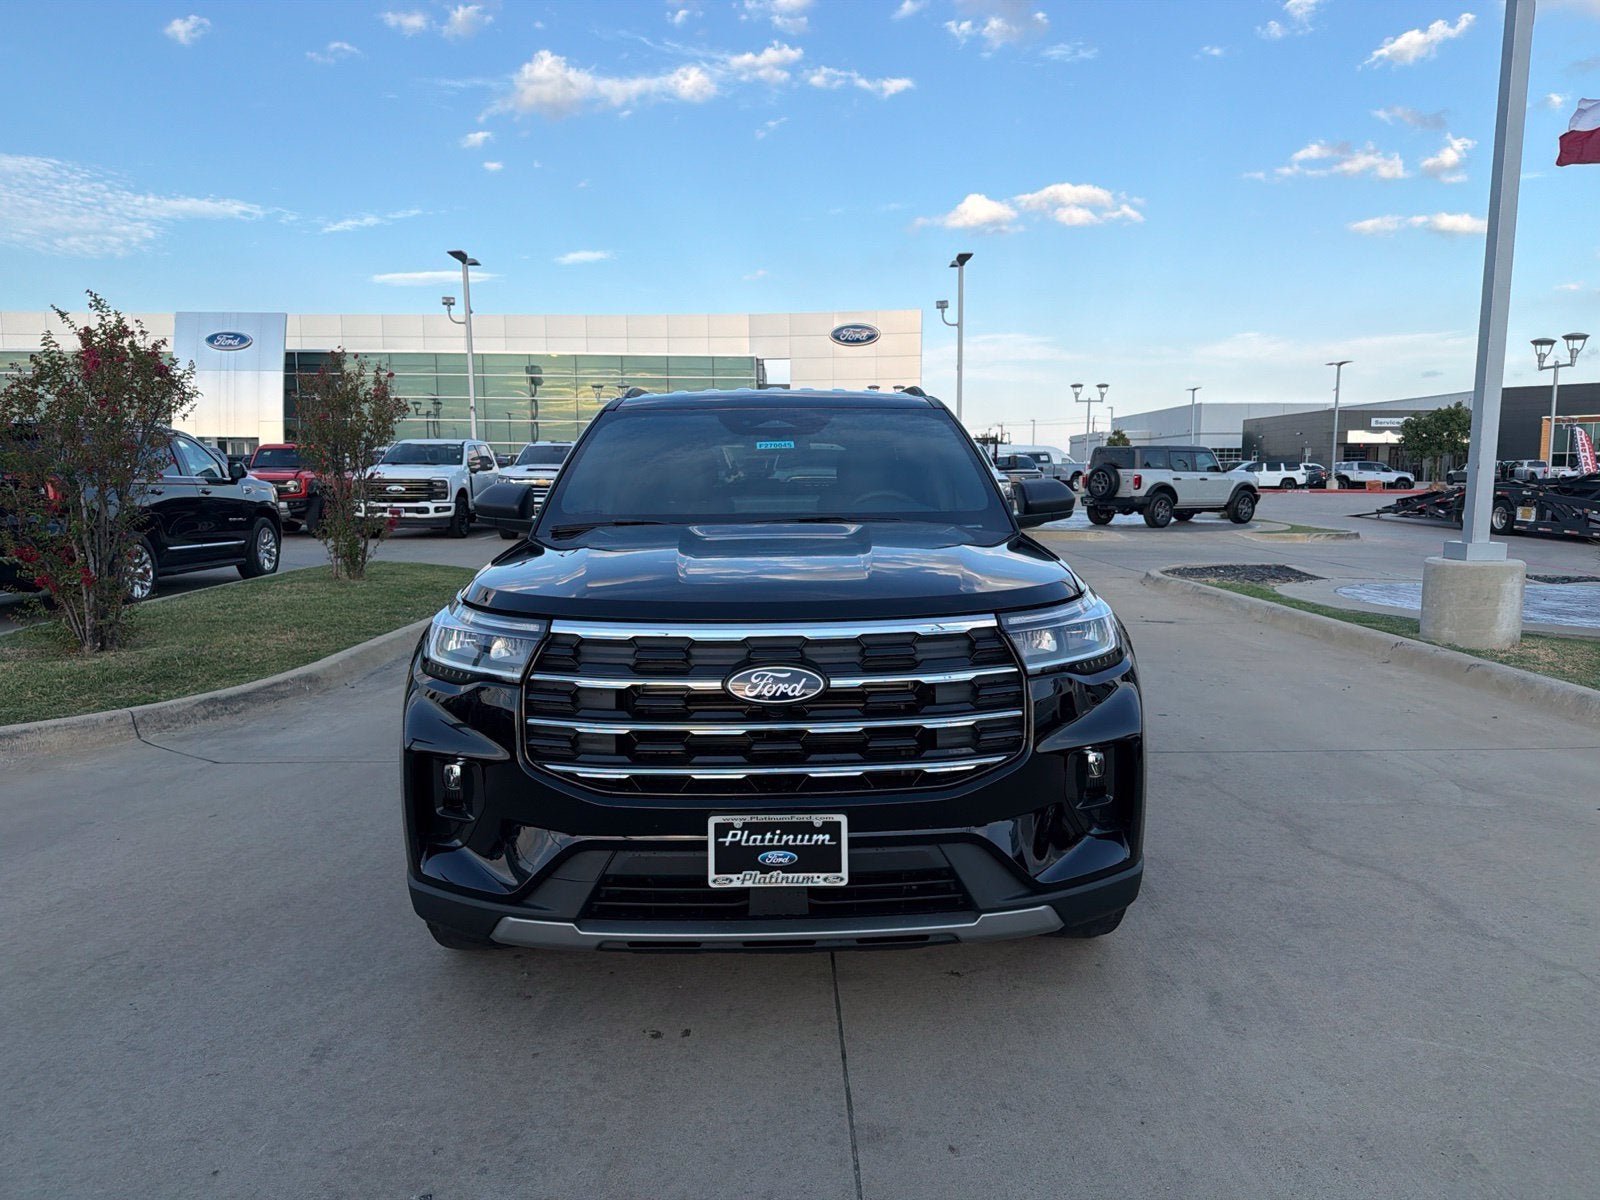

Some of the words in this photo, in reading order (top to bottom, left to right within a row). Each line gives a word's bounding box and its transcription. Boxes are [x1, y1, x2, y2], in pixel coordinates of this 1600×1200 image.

[213, 334, 241, 346] Ford
[840, 328, 868, 341] Ford
[745, 671, 807, 697] Ford
[718, 830, 837, 846] Platinum
[765, 853, 790, 864] Ford
[742, 872, 820, 885] Platinum
